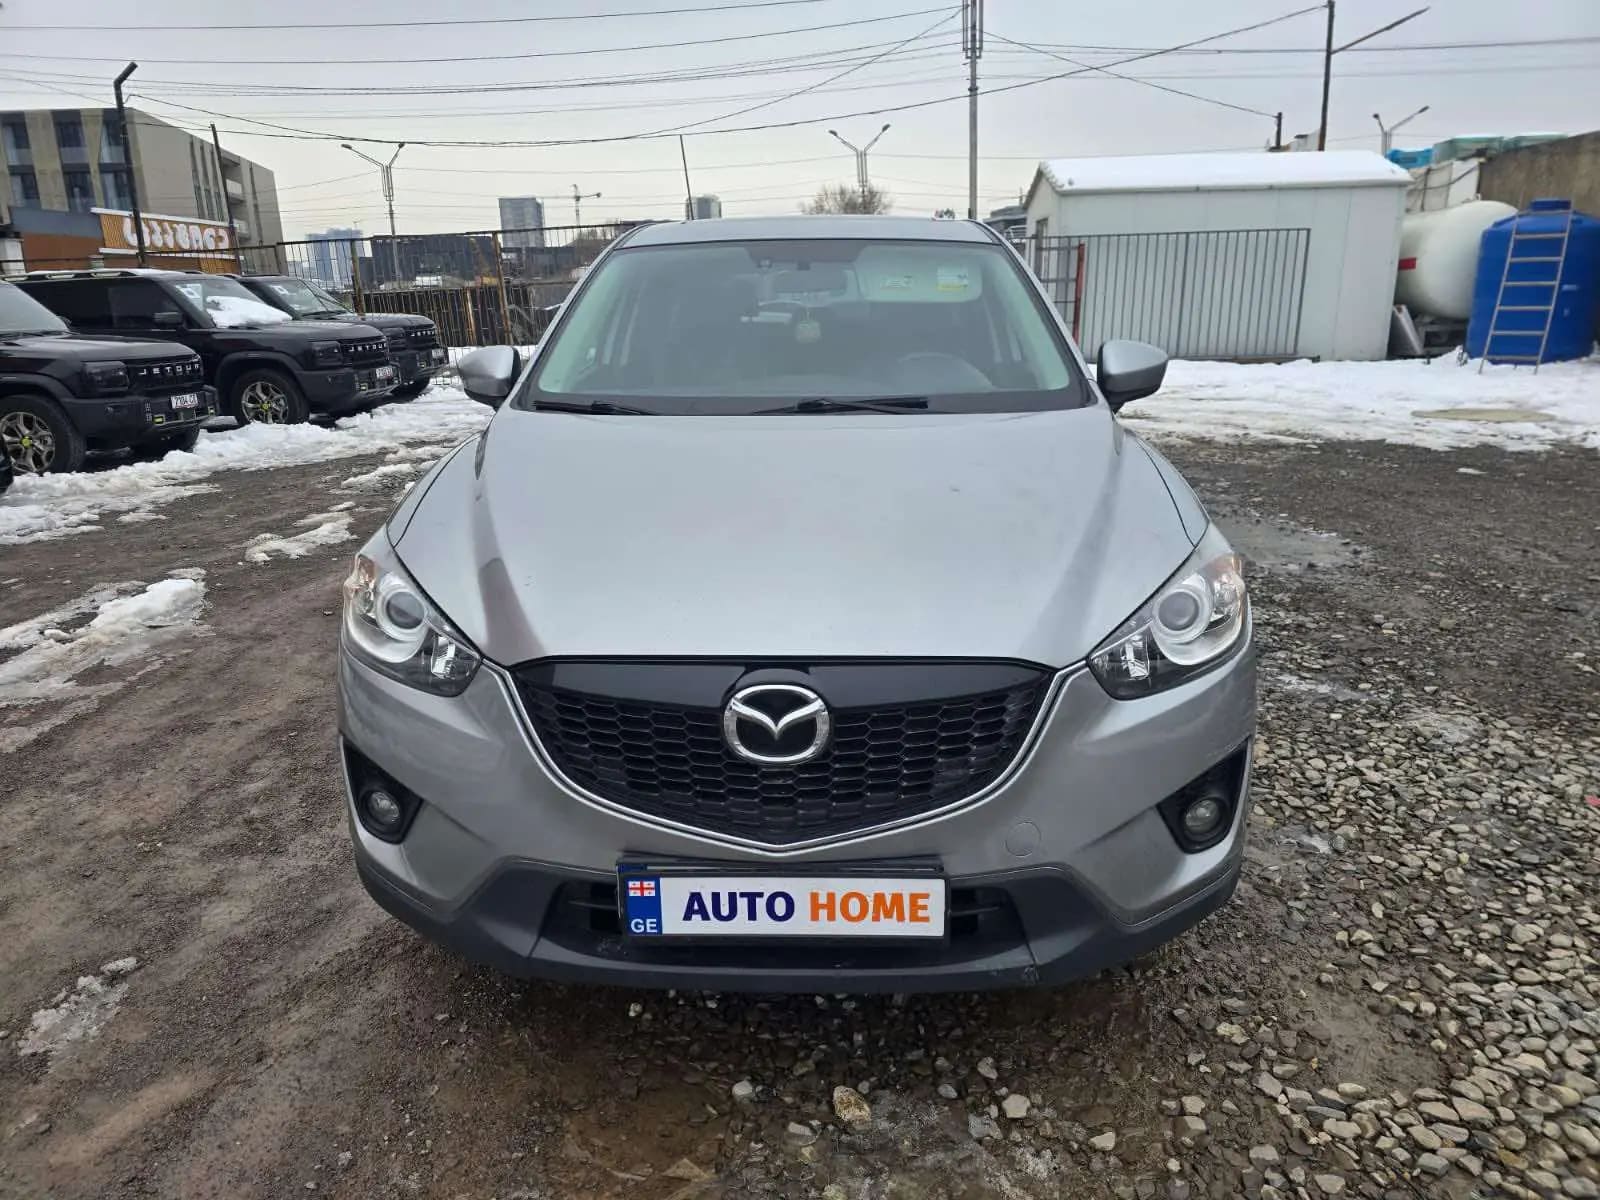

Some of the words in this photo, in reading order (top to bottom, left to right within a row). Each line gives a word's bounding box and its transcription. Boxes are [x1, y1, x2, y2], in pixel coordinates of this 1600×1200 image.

[682, 891, 795, 922] AUTO
[809, 892, 930, 923] HOME
[630, 918, 658, 934] GE
